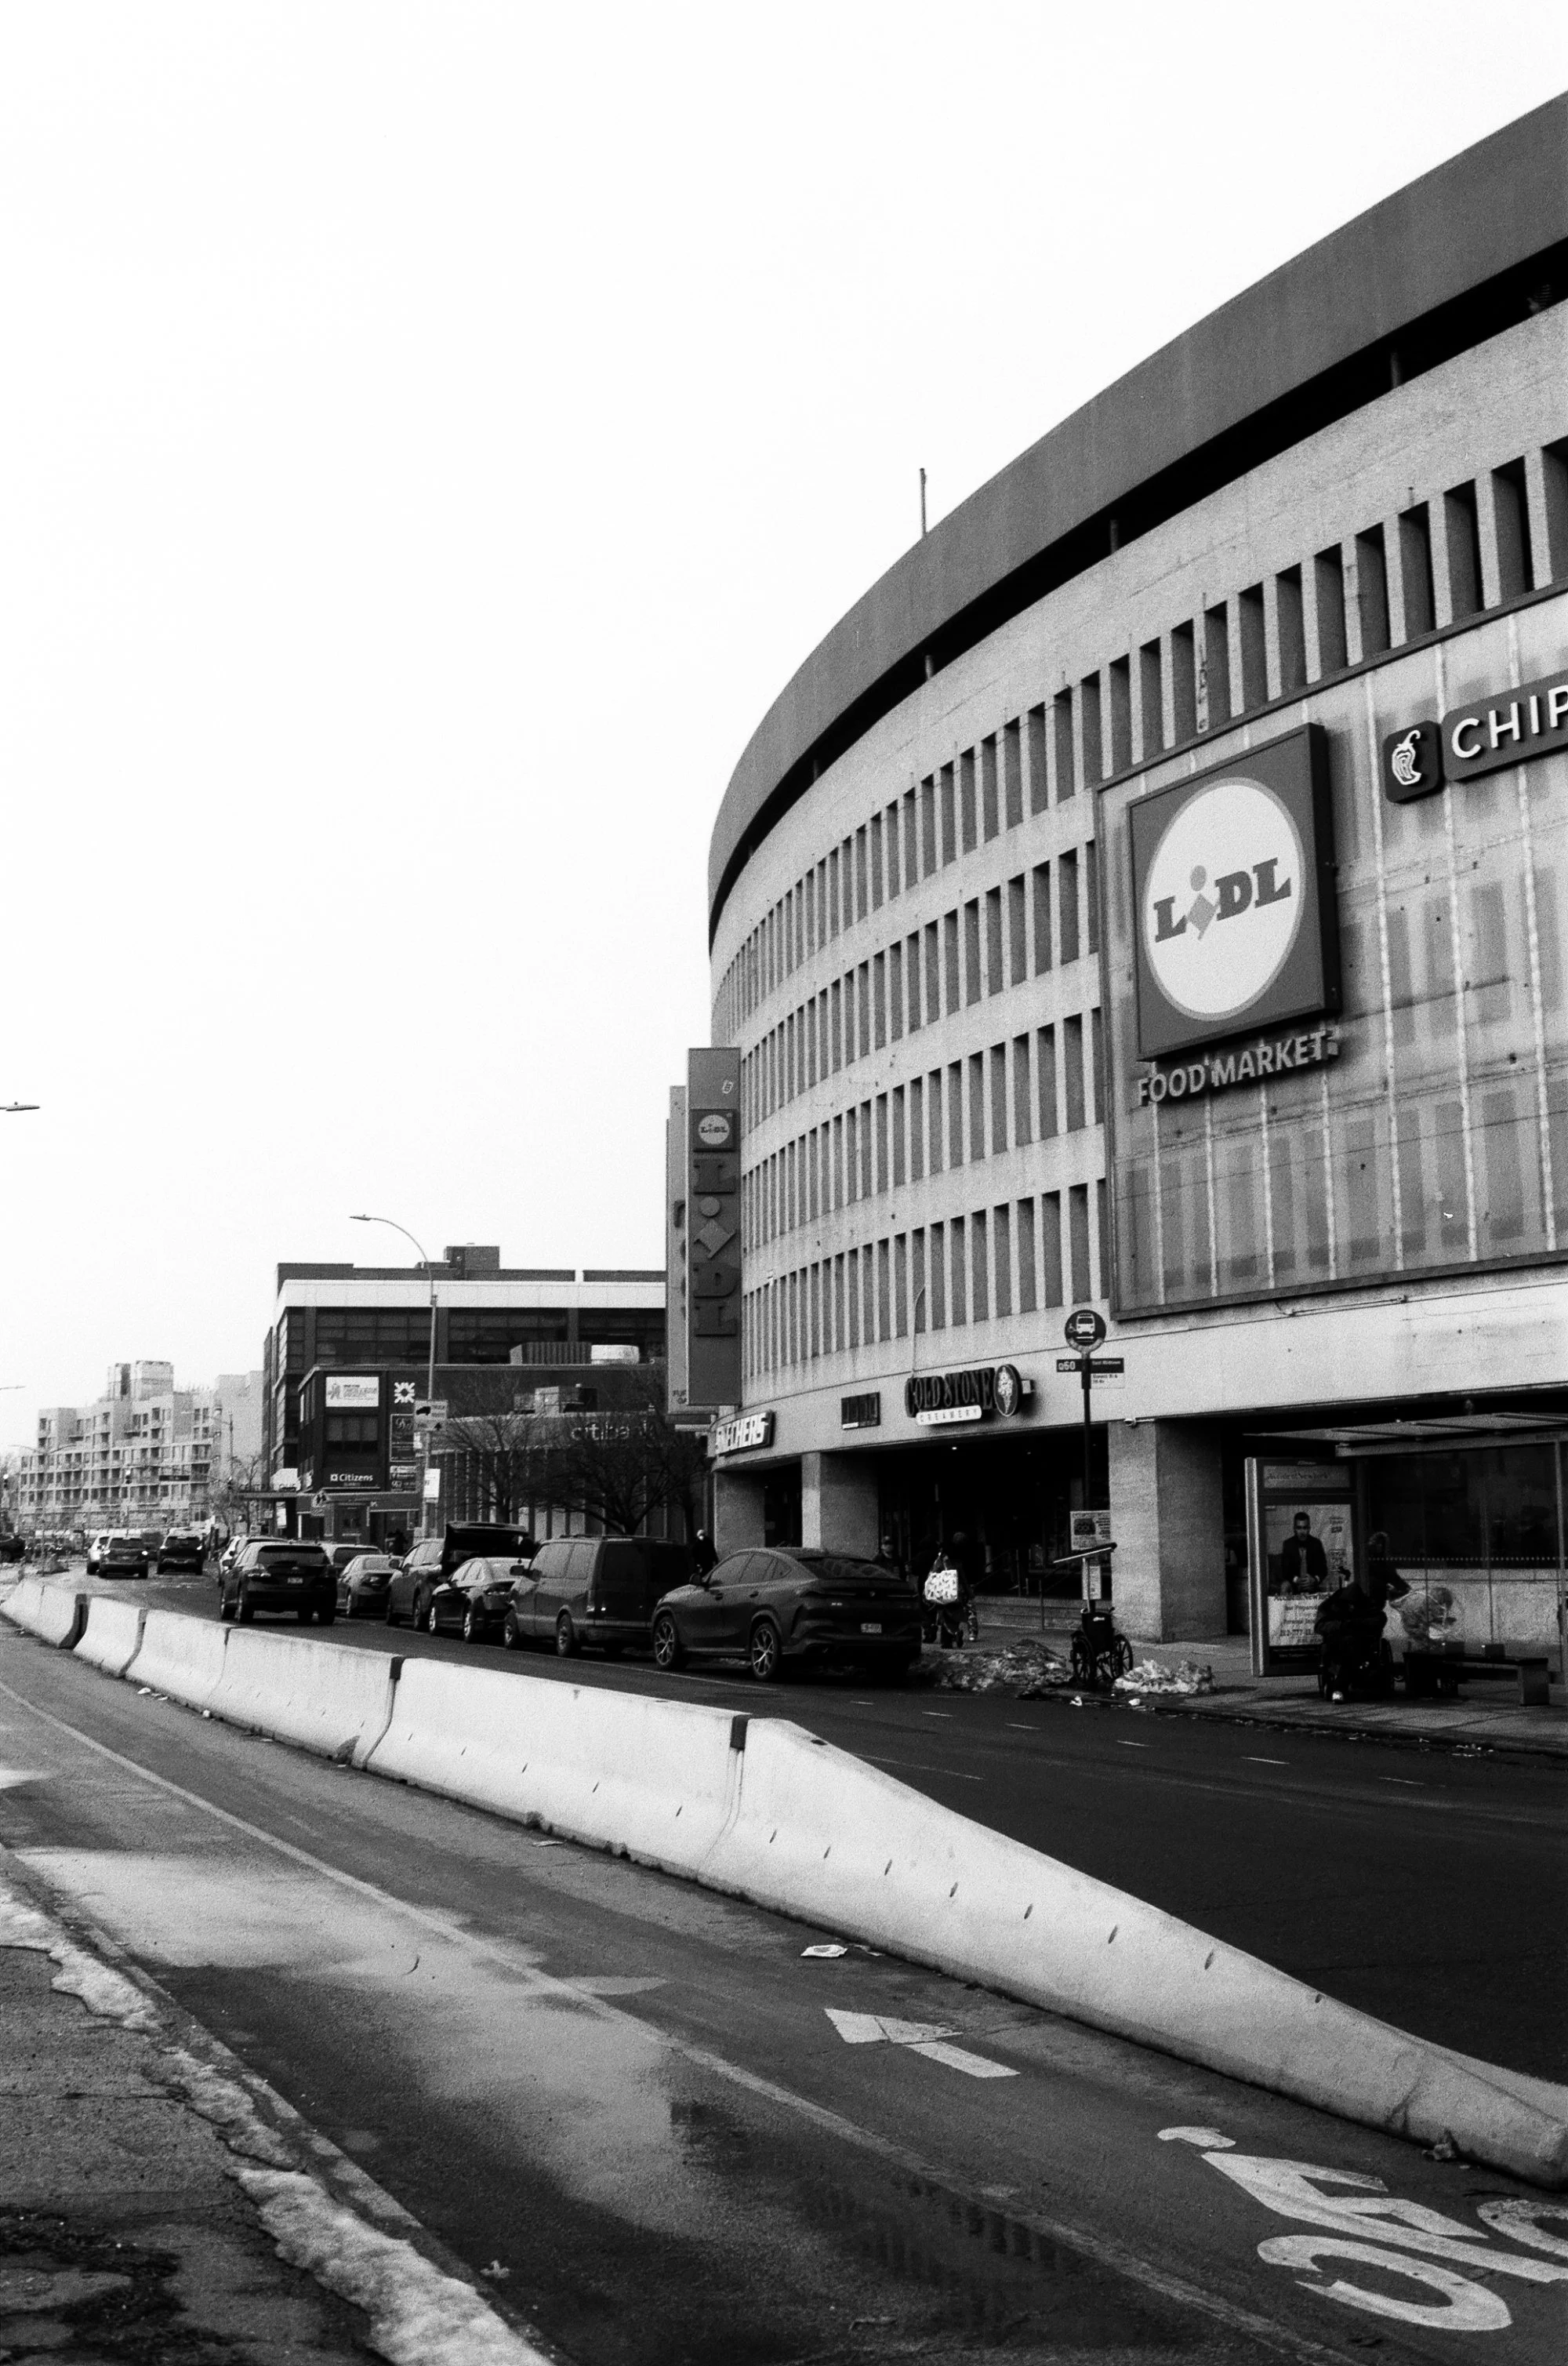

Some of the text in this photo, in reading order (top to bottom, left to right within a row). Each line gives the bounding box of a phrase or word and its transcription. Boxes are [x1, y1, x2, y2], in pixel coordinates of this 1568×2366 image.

[1451, 685, 1568, 758] CHIP
[1138, 1030, 1326, 1106] FOOD MARKET
[905, 1368, 996, 1417] COLD STONE
[339, 1473, 373, 1482] Citizens
